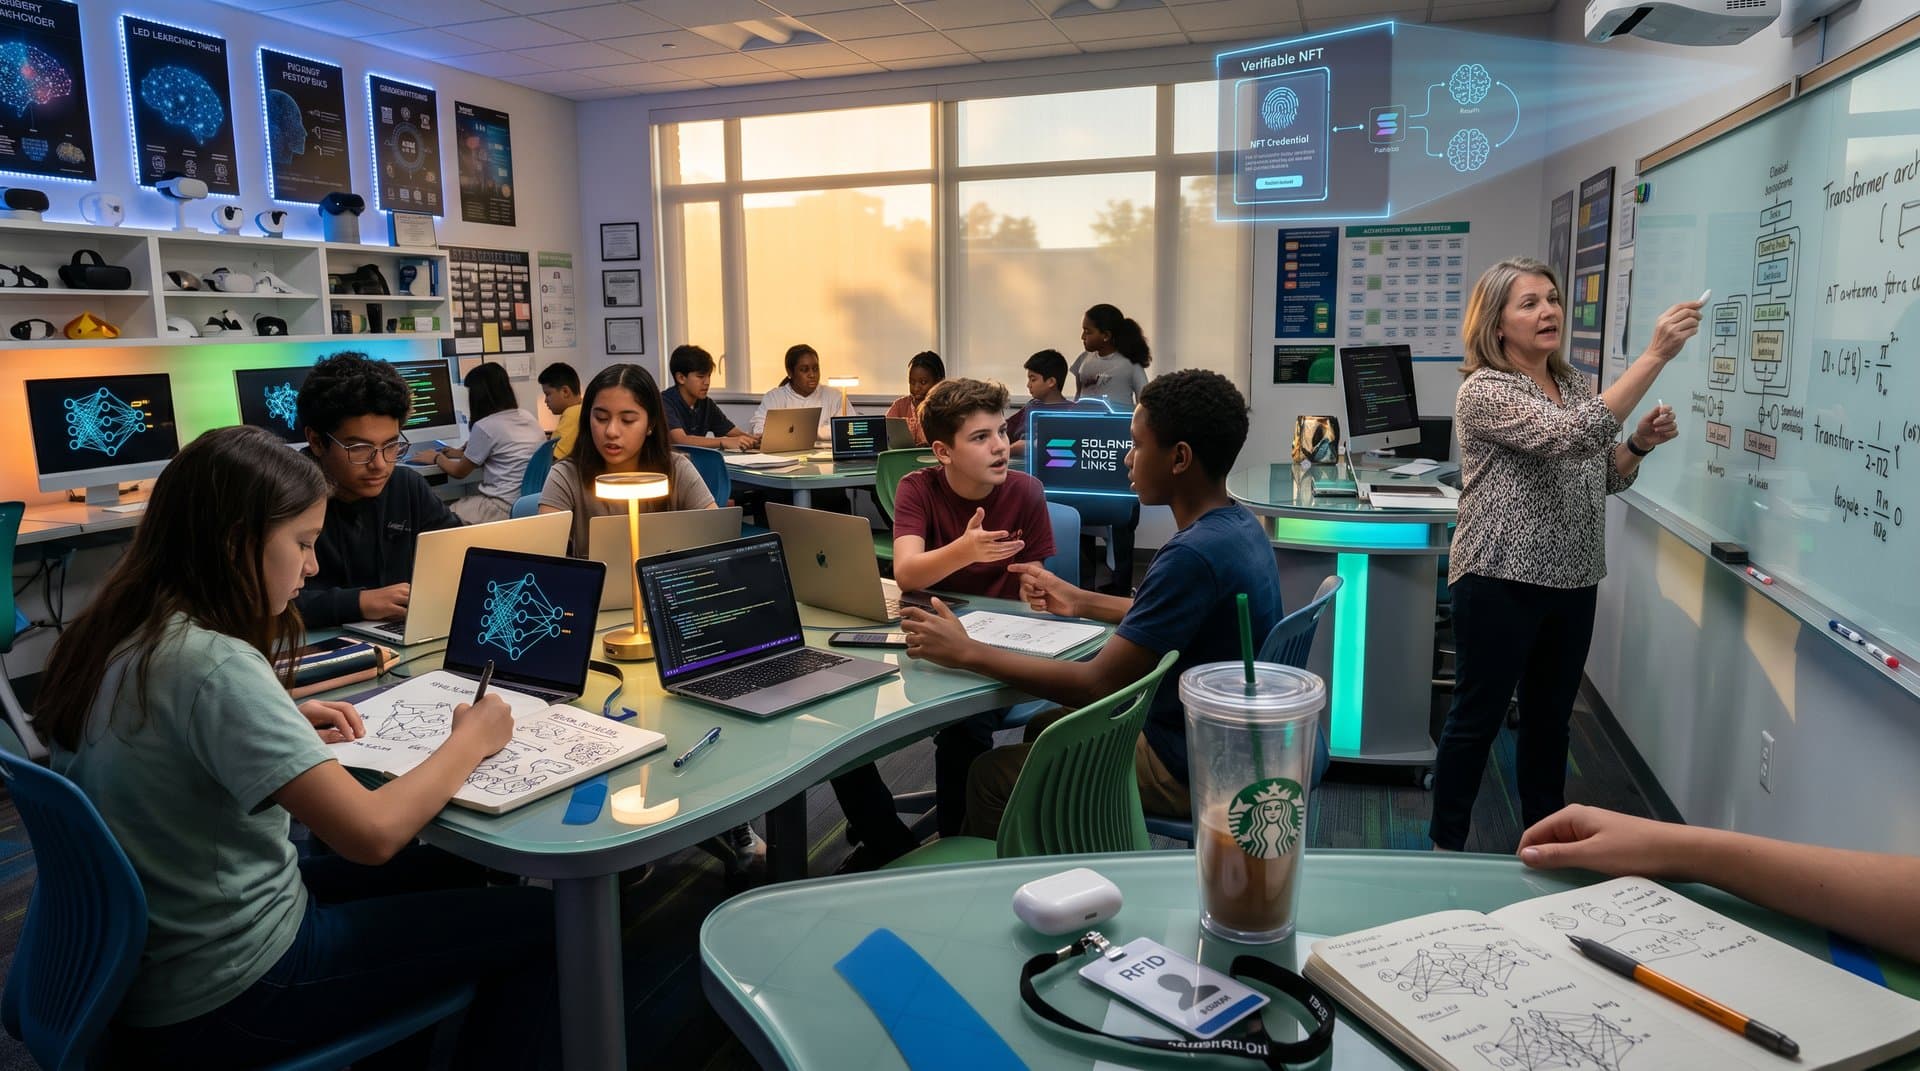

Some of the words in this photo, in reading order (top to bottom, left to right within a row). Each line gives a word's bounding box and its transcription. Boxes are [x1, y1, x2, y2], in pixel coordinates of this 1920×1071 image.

[132, 26, 150, 38] LED
[1241, 54, 1295, 73] Verifiable
[1299, 48, 1324, 63] NFT
[1250, 139, 1265, 149] NFT
[1823, 170, 1889, 210] Transformer
[1081, 438, 1134, 449] SOLANA
[1081, 449, 1118, 460] NODE
[1080, 460, 1117, 471] LINKS
[1119, 954, 1165, 981] RFID
